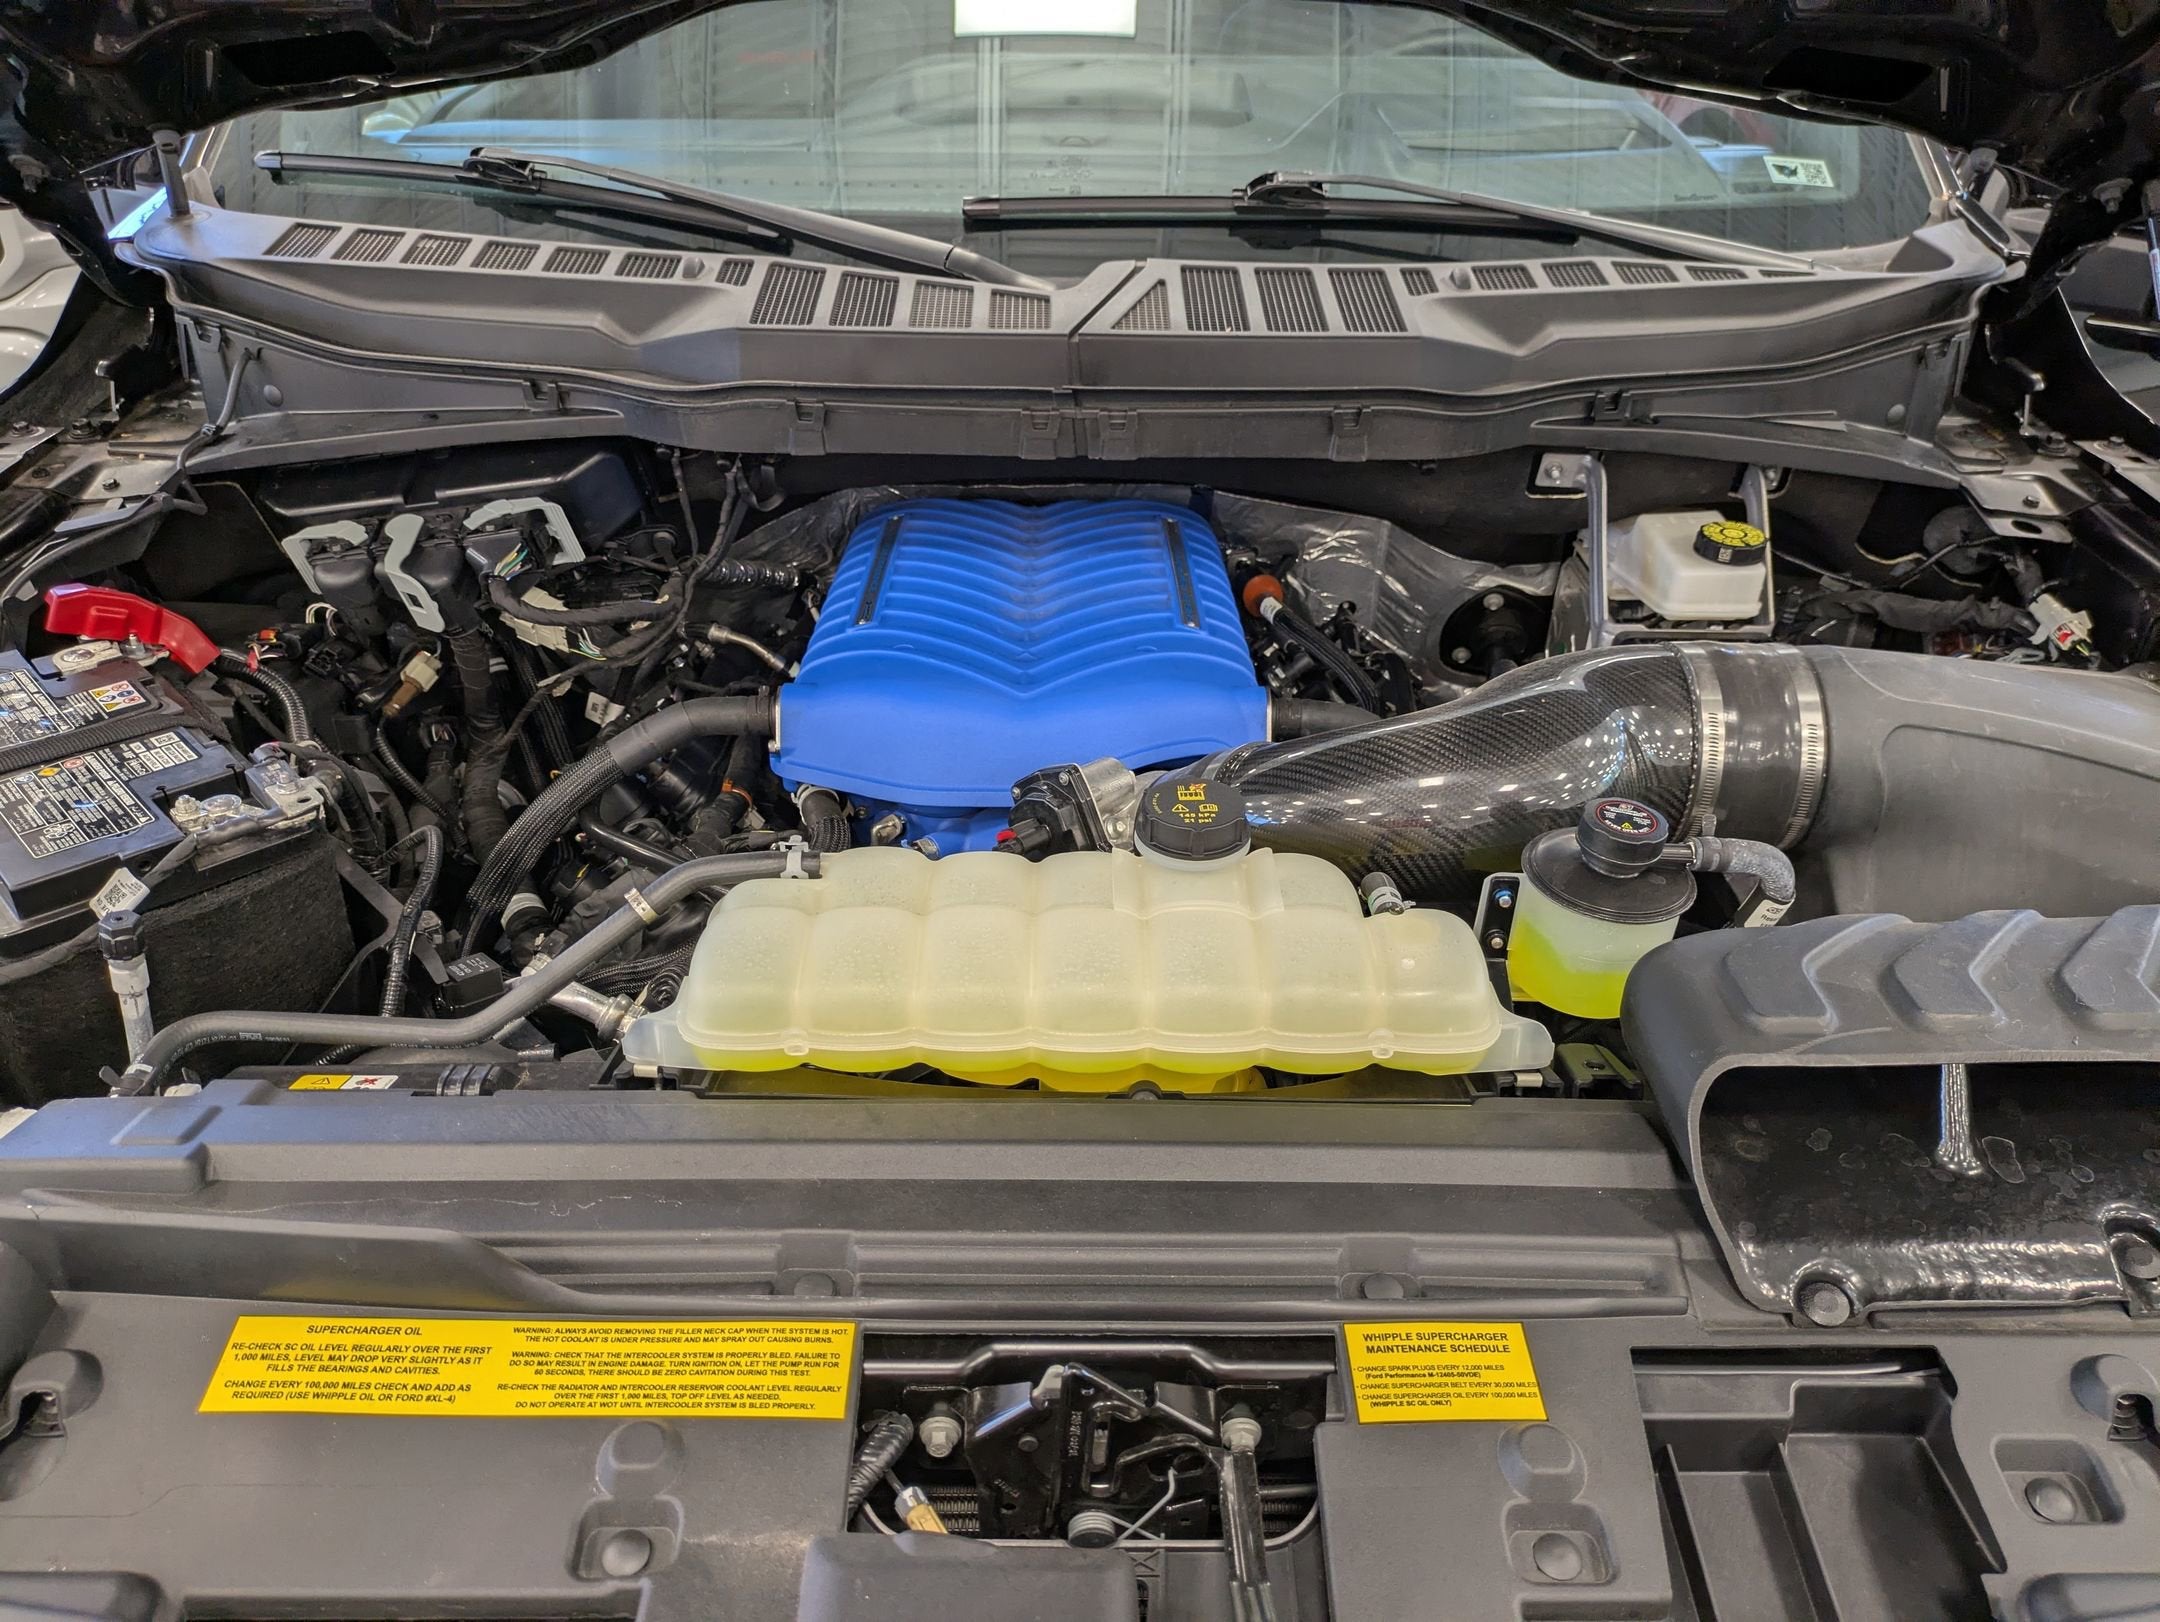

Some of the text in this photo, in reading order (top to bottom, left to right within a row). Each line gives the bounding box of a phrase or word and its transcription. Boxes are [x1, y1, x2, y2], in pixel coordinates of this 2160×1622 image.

[306, 1325, 423, 1336] SUPERCHARGER OIL
[1416, 1333, 1508, 1341] SUPERCHARGER
[1366, 1345, 1447, 1353] MAINTENANCE
[318, 1365, 369, 1373] BEARINGS
[232, 1392, 284, 1400] REQUIRED
[312, 1393, 356, 1402] WHIPPLE
[395, 1394, 424, 1402] FORD
